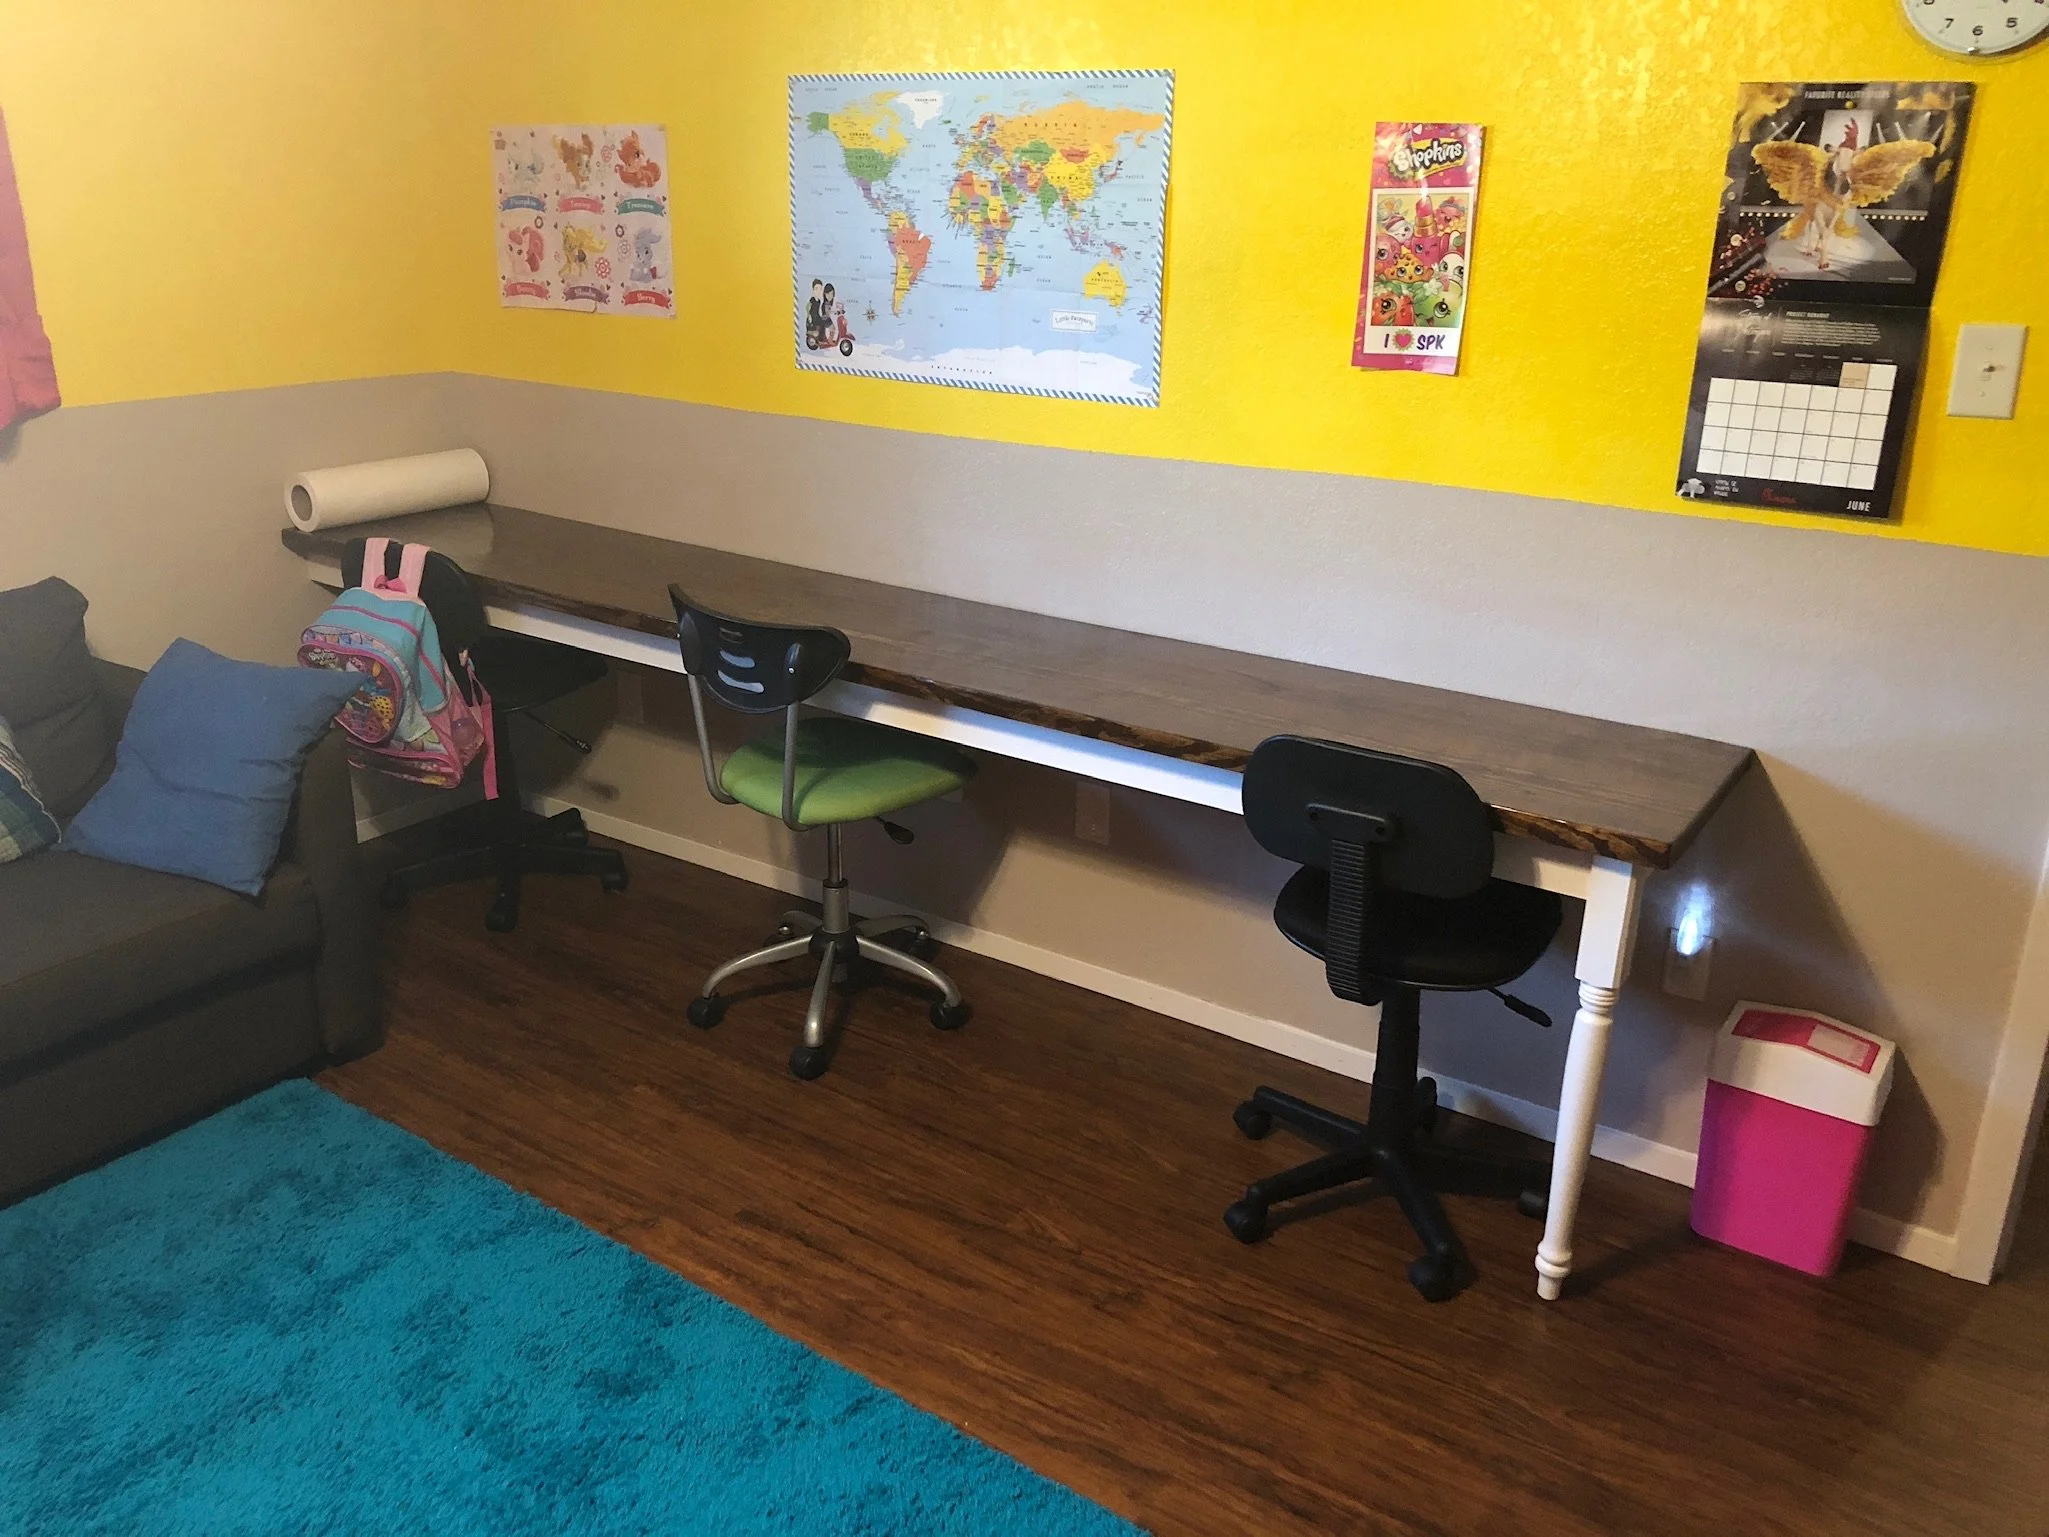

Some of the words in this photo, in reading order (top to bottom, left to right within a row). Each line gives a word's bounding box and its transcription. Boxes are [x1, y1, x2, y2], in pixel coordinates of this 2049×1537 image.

[1944, 18, 1954, 28] 7
[2006, 17, 2018, 28] 5
[1972, 25, 1984, 36] 6
[1392, 140, 1463, 172] Shopkins
[1384, 333, 1390, 349] I
[1416, 334, 1446, 351] SPK
[1846, 500, 1871, 512] JUNE
